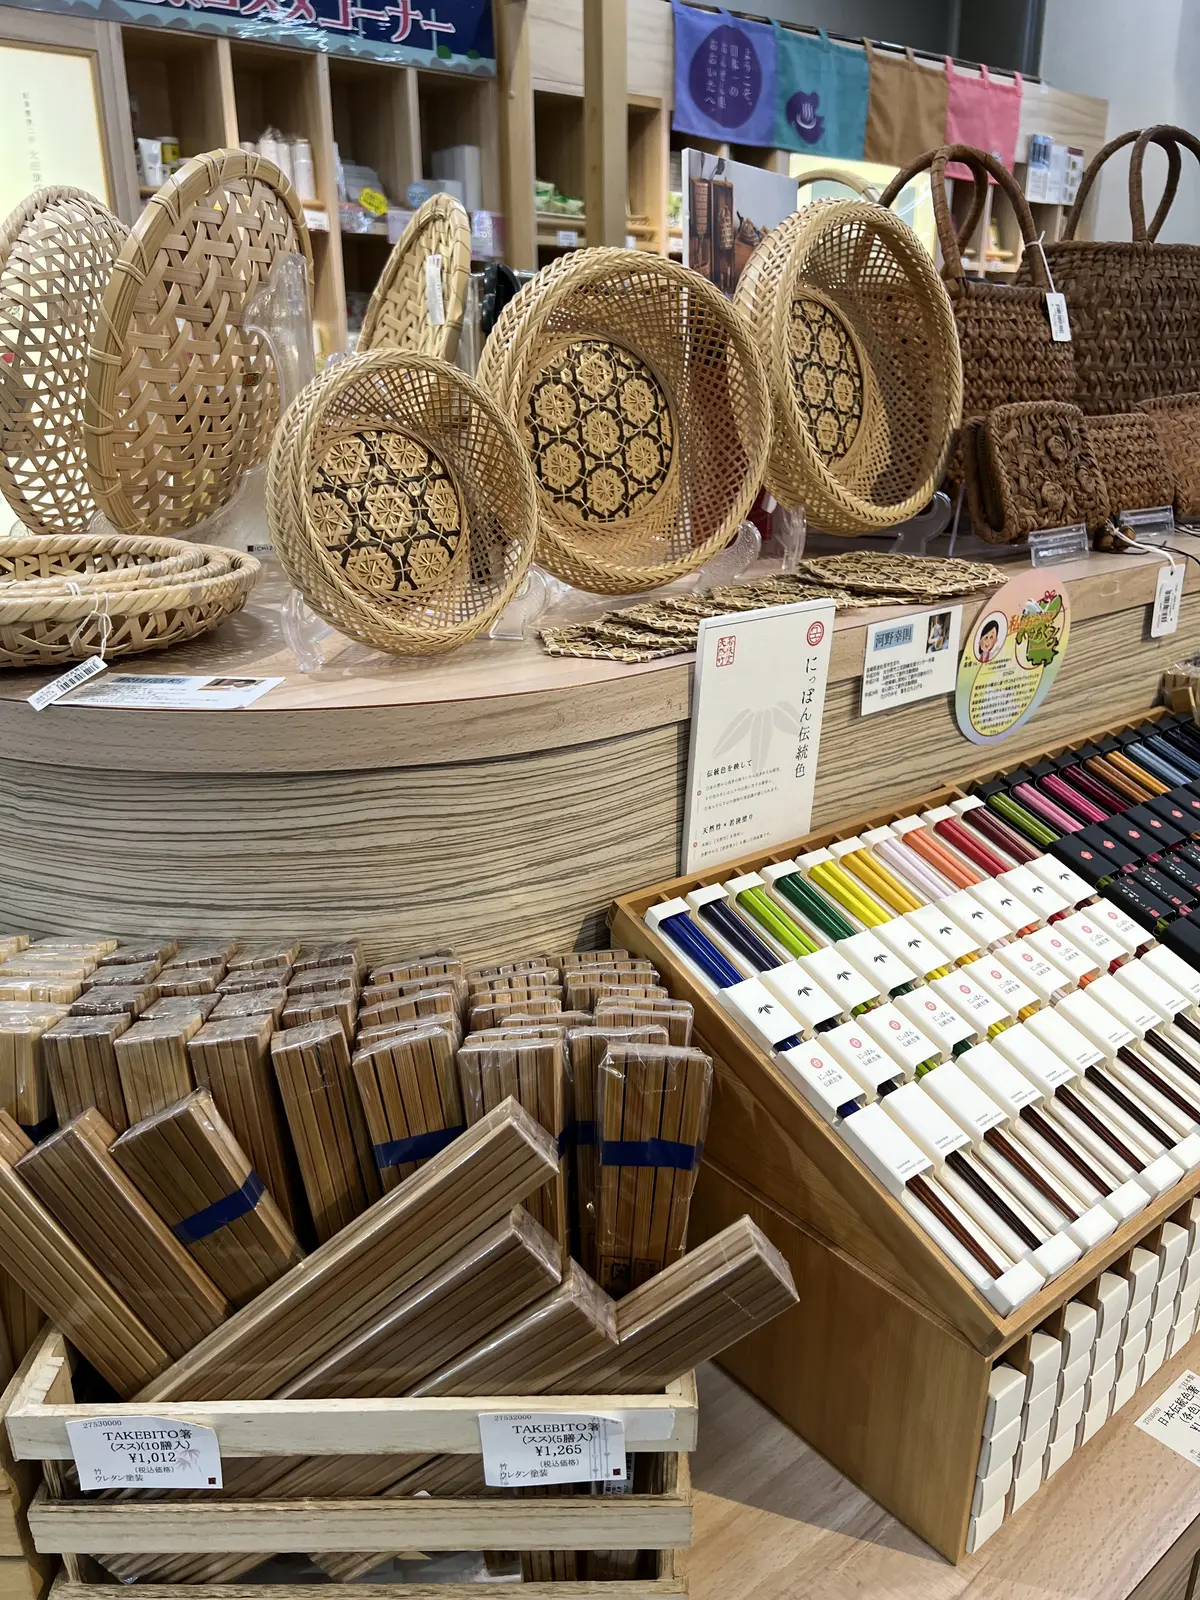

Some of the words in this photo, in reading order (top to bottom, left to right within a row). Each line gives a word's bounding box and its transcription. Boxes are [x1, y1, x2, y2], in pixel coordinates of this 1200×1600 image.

[875, 626, 912, 648] 河野幸則
[795, 656, 818, 778] にっぽん伝統色
[706, 759, 753, 778] 伝統色を映して
[1158, 1385, 1200, 1427] 日本伝統色箸
[83, 1419, 122, 1429] 27530000
[512, 1422, 599, 1434] TAKEBITO箸
[103, 1429, 192, 1441] TAKEBITO箸
[522, 1433, 593, 1445] (スス)(5膳入)
[110, 1440, 190, 1452] (スス)(10膳入)
[535, 1444, 582, 1457] ¥1,265
[128, 1451, 176, 1465] ¥1,012
[539, 1458, 580, 1468] (税込価格)
[134, 1466, 175, 1474] (税込価格)
[499, 1462, 508, 1471] 竹
[95, 1474, 144, 1482] ウレタン塗装
[500, 1468, 548, 1480] ウレタン塗装
